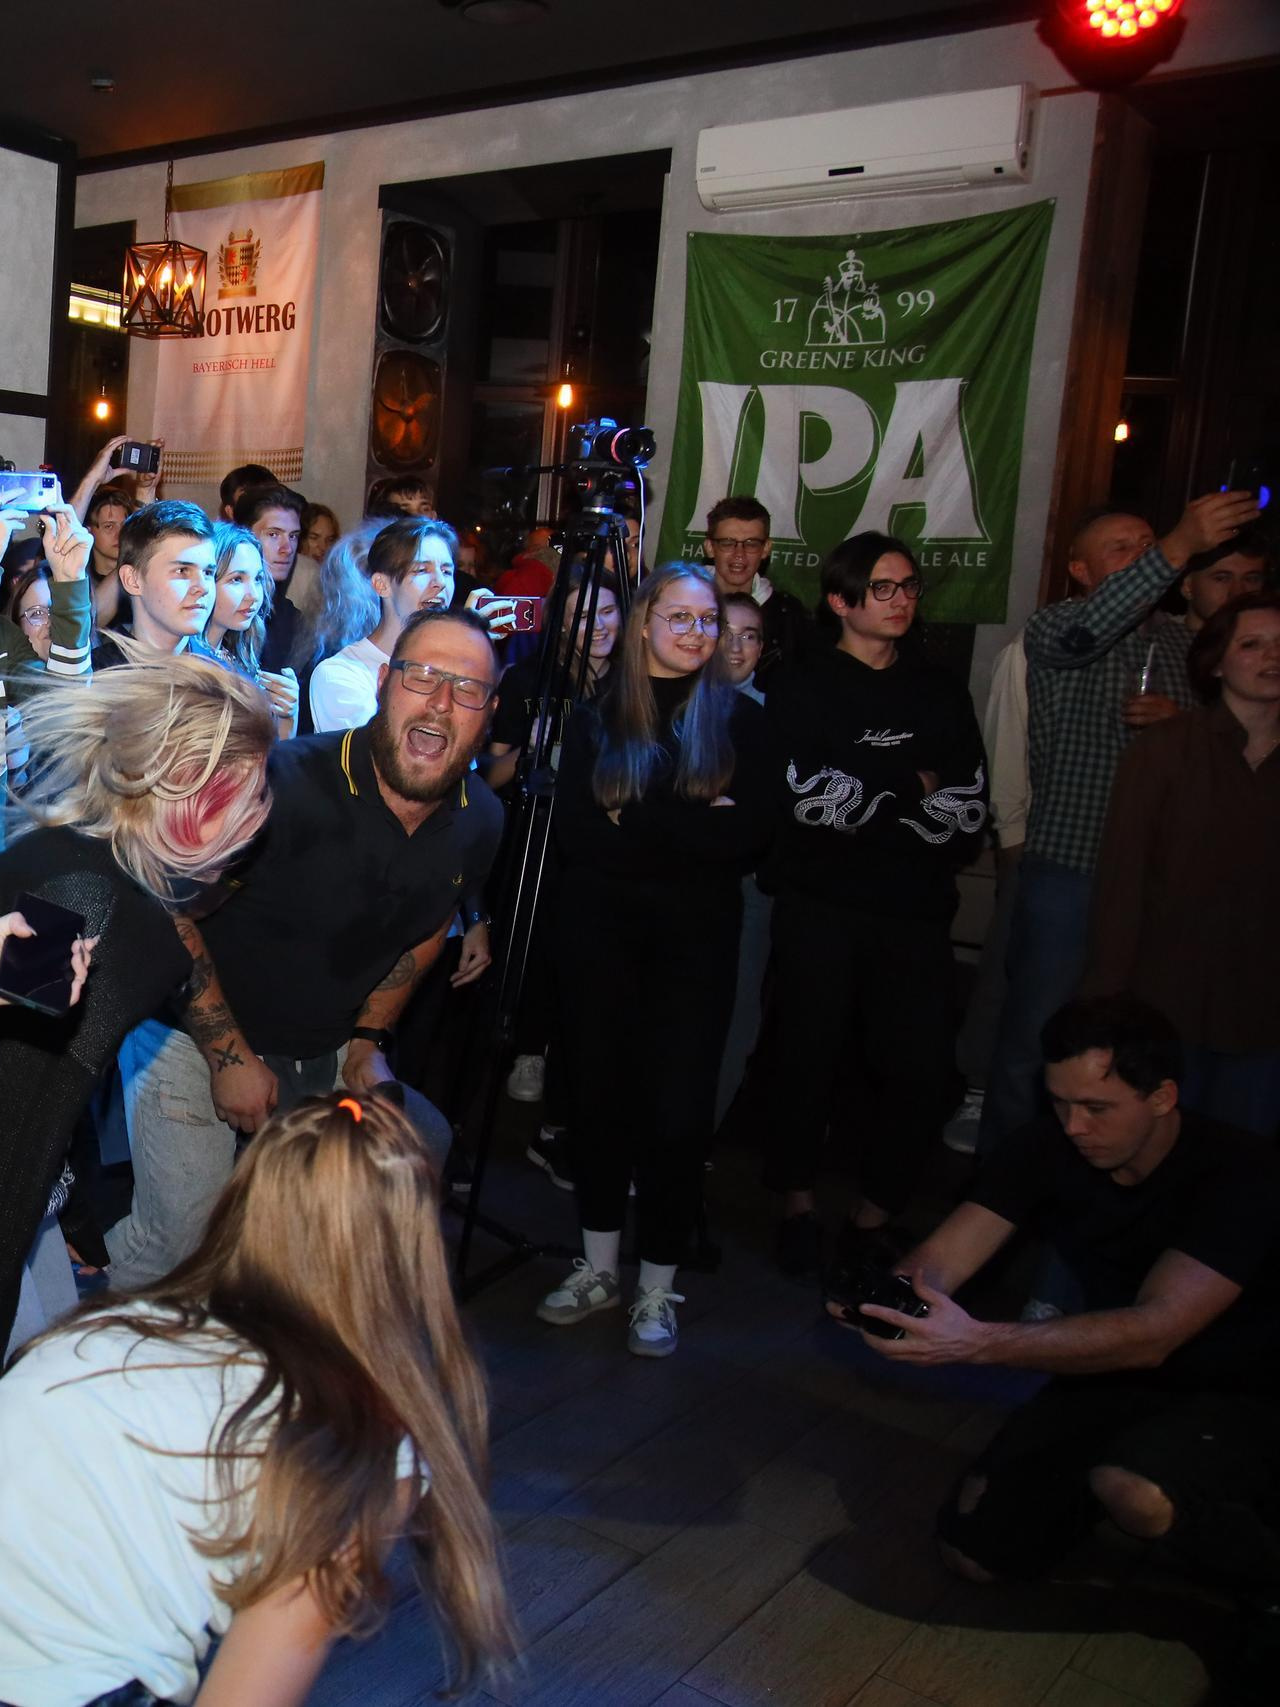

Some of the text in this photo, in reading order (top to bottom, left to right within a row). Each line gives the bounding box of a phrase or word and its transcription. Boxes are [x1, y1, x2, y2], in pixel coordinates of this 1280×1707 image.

[182, 301, 296, 338] OTWERG
[772, 289, 935, 324] 17 99
[192, 357, 277, 374] BAYERISCH HELL
[759, 345, 927, 370] GREENE KING
[686, 376, 992, 546] IPA
[949, 551, 987, 567] ALE
